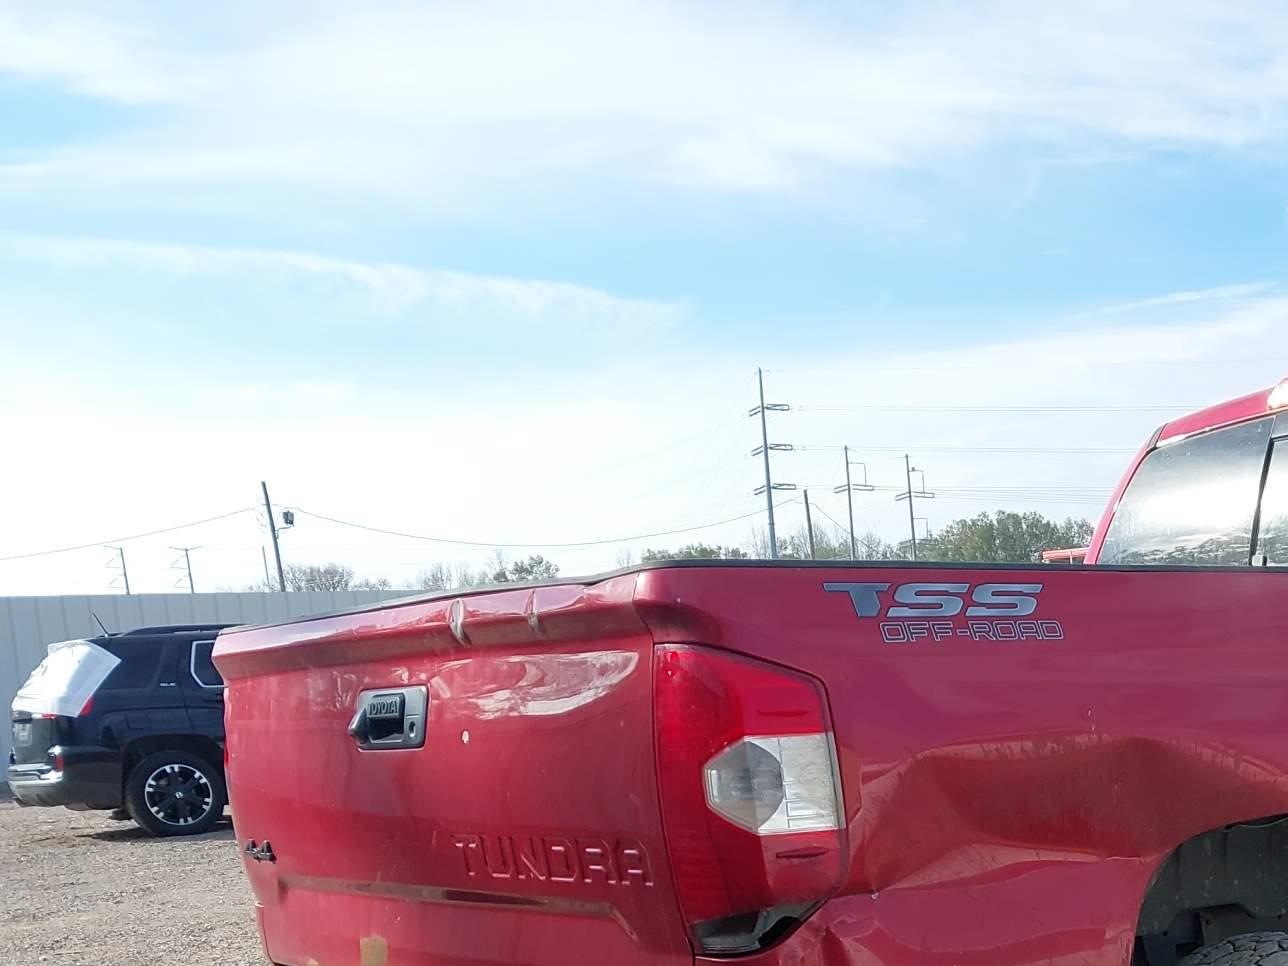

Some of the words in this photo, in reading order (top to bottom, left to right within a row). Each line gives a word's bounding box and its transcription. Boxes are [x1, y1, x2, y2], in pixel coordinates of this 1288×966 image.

[822, 582, 1045, 618] TSS
[879, 620, 1064, 643] OFF-ROAD
[367, 699, 398, 716] TOYOTA
[453, 834, 654, 887] TUNDRA
